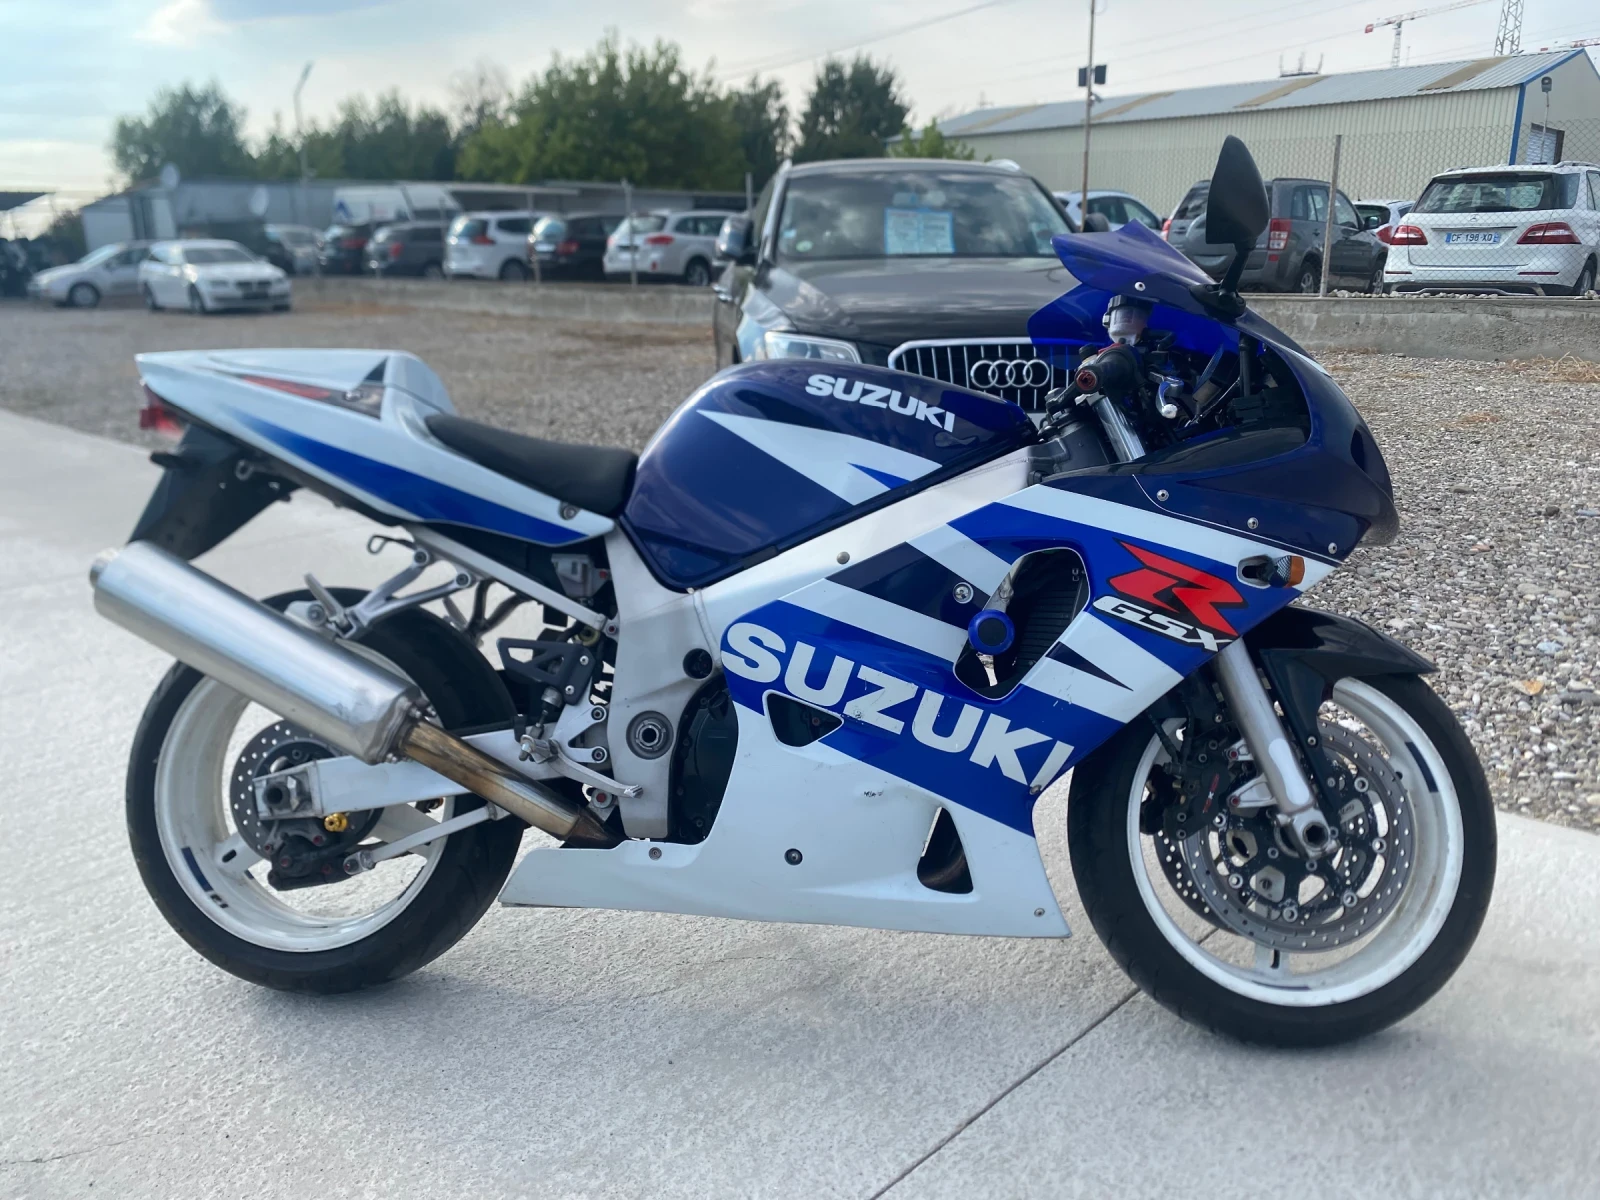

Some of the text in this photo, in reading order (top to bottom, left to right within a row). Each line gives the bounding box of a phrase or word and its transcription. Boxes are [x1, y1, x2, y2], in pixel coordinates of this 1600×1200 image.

[805, 374, 955, 433] SUZUKI
[1093, 595, 1233, 652] GSX
[721, 622, 1075, 791] SUZUKI
